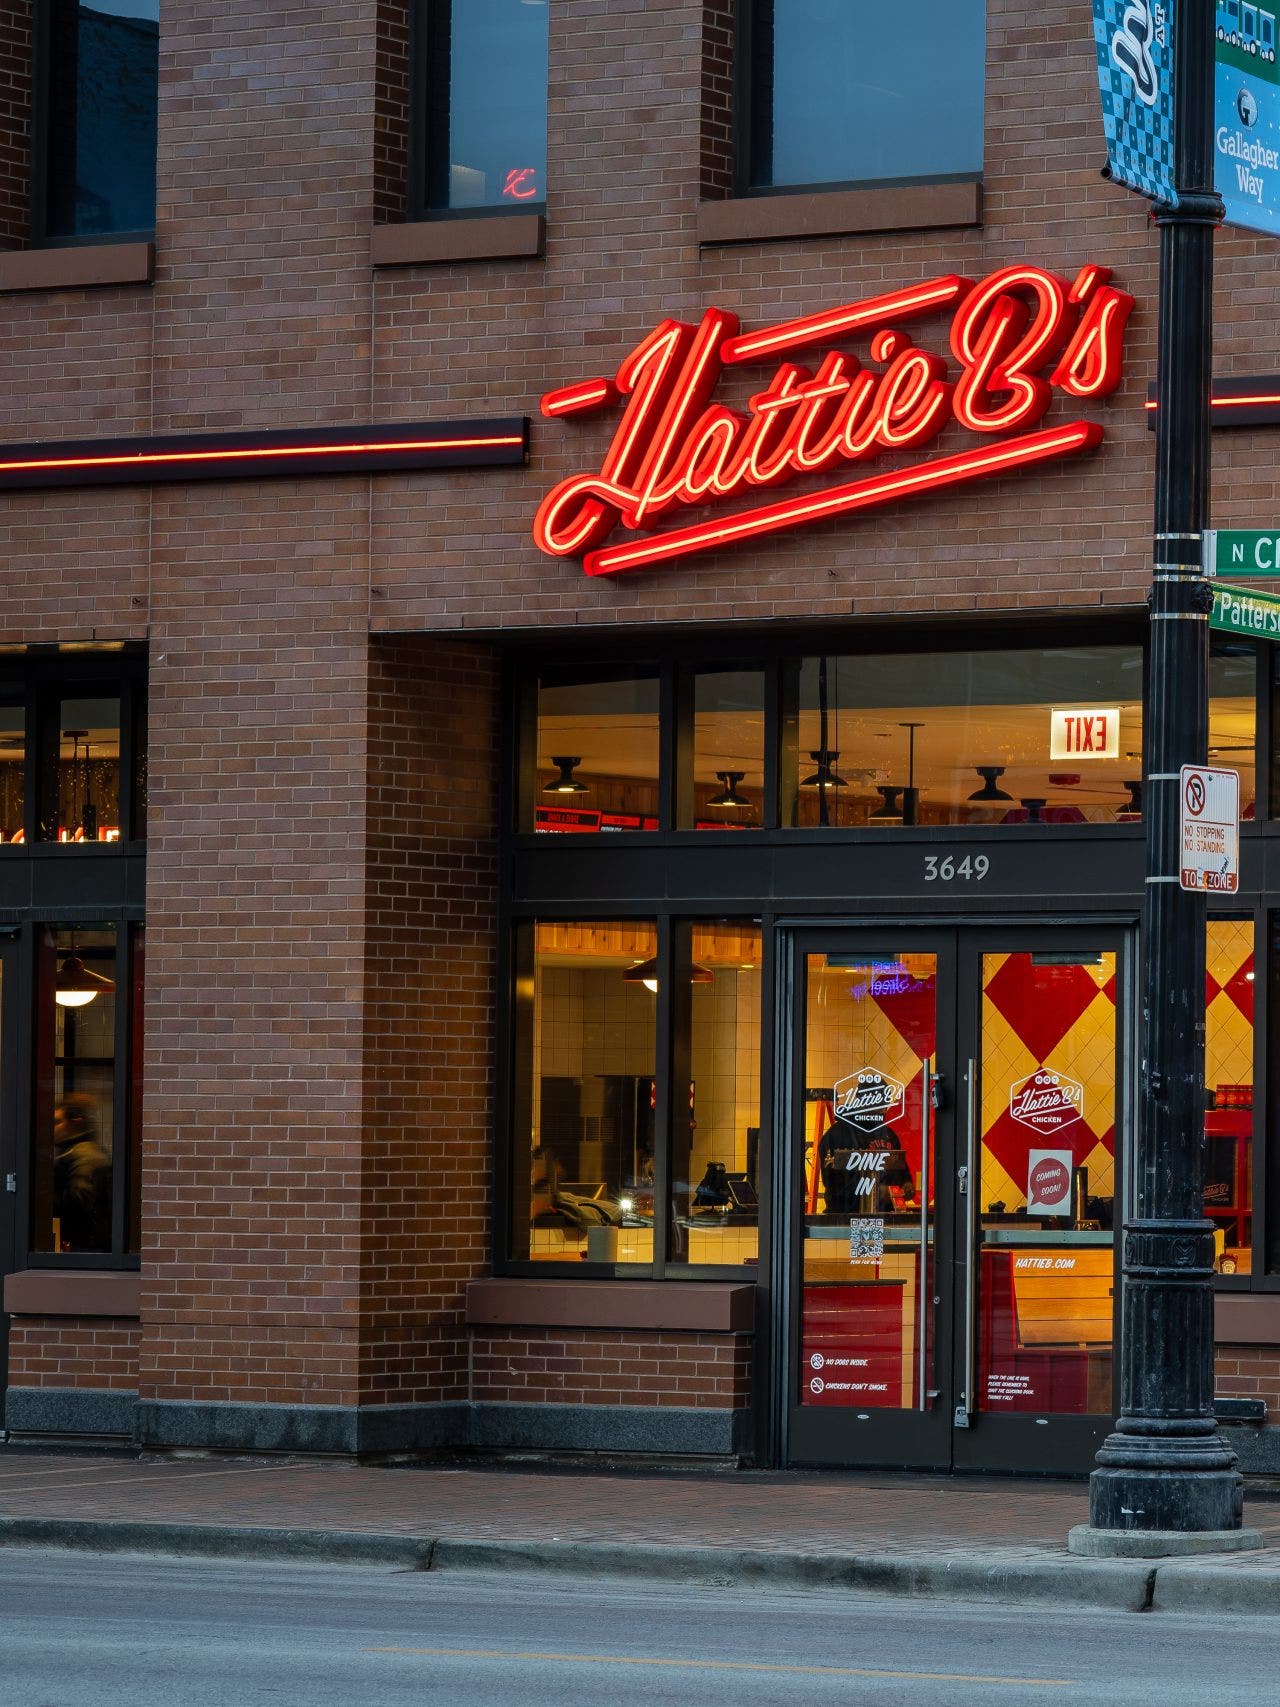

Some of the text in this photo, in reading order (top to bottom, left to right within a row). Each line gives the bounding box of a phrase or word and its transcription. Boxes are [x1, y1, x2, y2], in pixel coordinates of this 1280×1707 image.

[1216, 126, 1279, 170] Gallagher
[1235, 164, 1264, 204] Way
[533, 264, 1134, 556] Hattie B's
[1232, 543, 1244, 562] N
[1185, 825, 1225, 840] NO STOPPING
[1185, 840, 1225, 854] NO STANDING
[924, 855, 990, 881] 3649
[1208, 872, 1233, 889] ZONE
[858, 1074, 881, 1083] HOT
[1035, 1075, 1059, 1084] HOT
[836, 1085, 902, 1114] Hattie B's
[1013, 1086, 1081, 1116] Hattie B's
[846, 1152, 891, 1171] DINE
[1036, 1168, 1061, 1182] COMING
[855, 1177, 876, 1196] IN
[1041, 1184, 1062, 1196] SOON!
[1016, 1258, 1076, 1269] HATTIEB.COM
